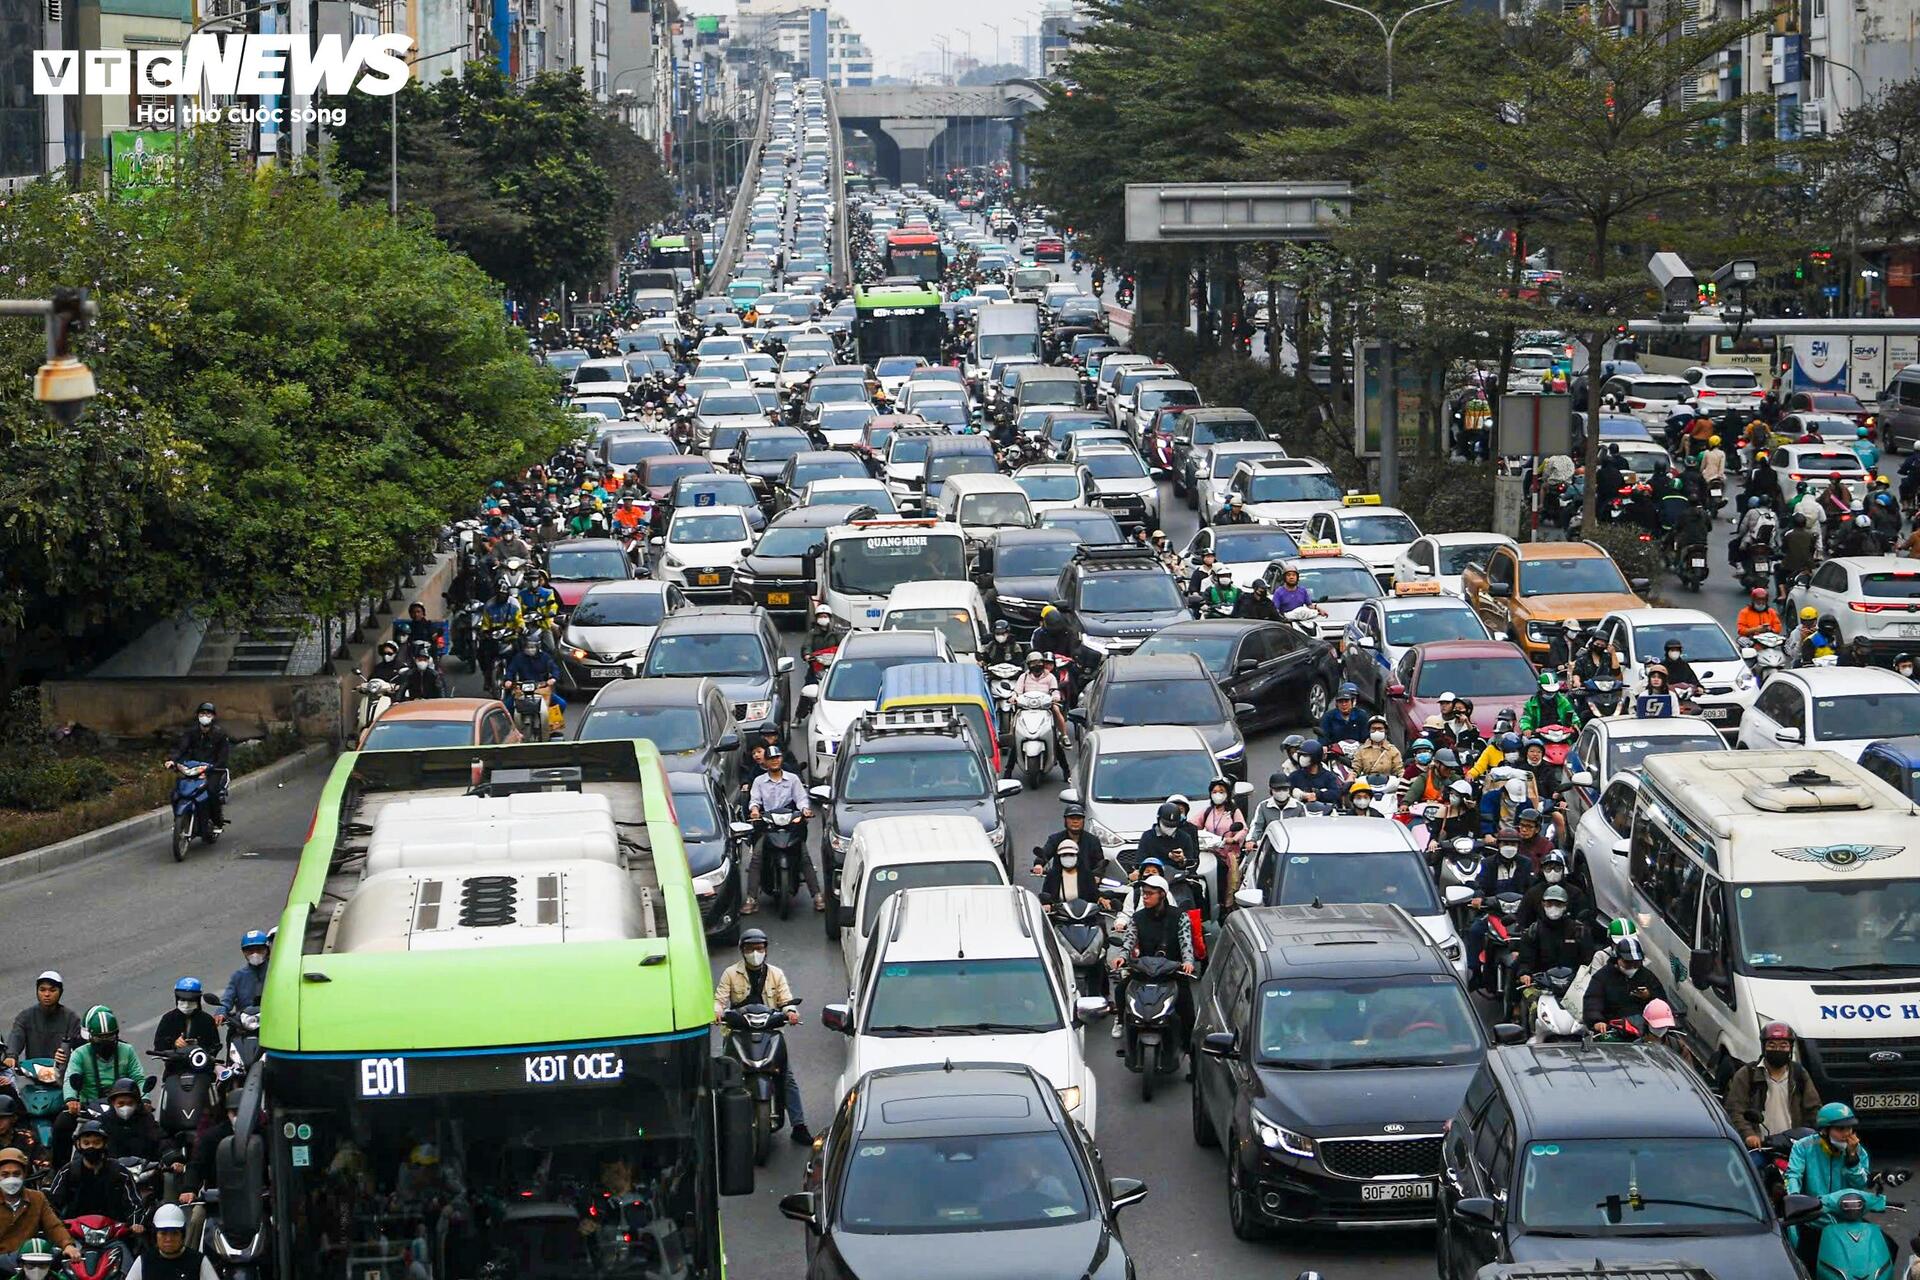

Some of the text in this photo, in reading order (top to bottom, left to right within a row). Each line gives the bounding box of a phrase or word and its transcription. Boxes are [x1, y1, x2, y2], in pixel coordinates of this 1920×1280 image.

[867, 536, 928, 549] QUANG MINH
[1820, 1004, 1892, 1022] NGỌC
[361, 1057, 406, 1096] E01
[525, 1055, 568, 1082] KĐT
[1385, 1124, 1403, 1132] KIA
